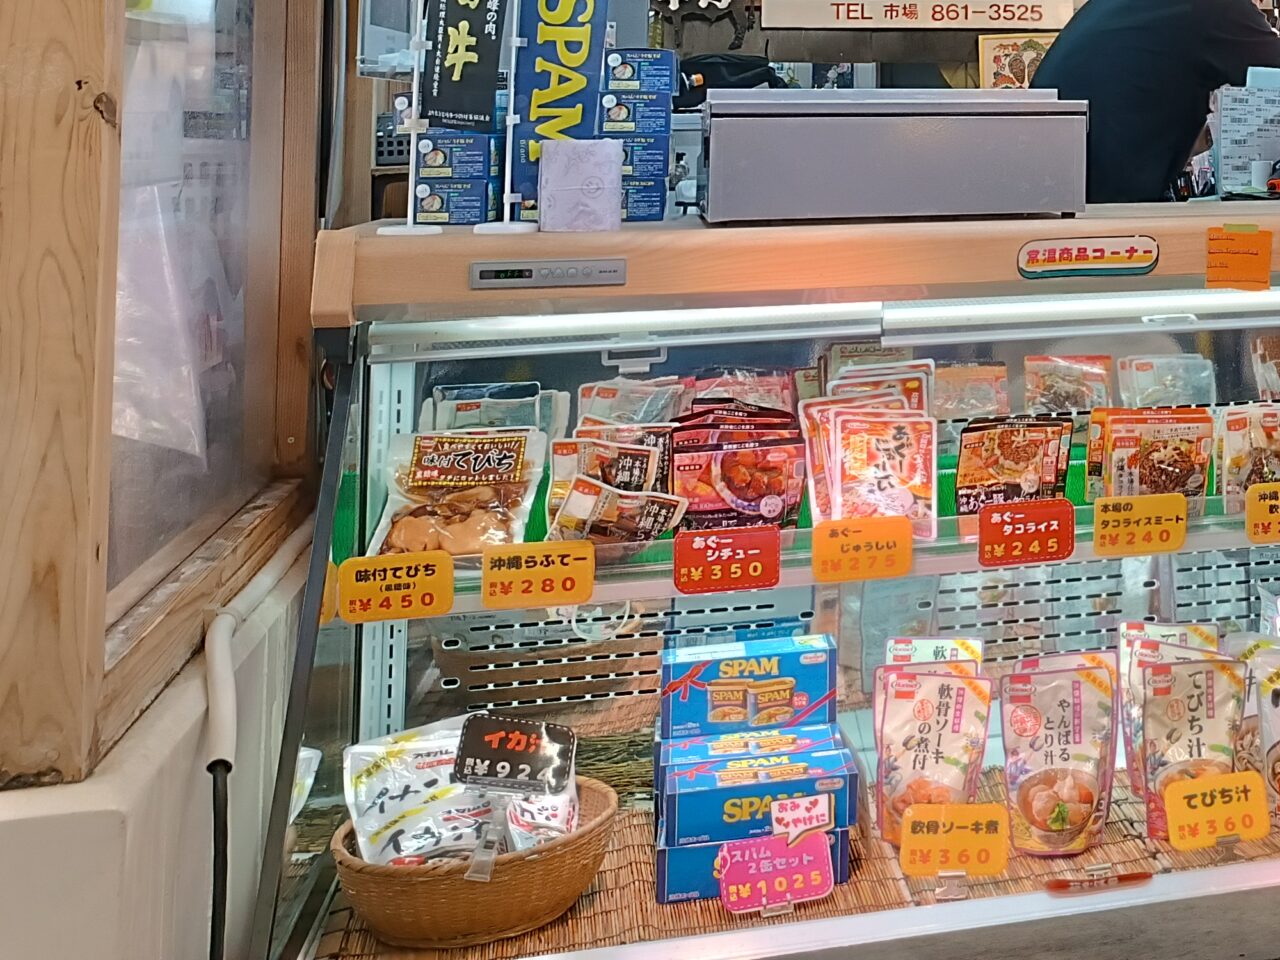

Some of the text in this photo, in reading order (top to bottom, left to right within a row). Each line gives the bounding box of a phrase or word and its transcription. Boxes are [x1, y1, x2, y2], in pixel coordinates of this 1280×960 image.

[830, 2, 1043, 23] TEL 市場 861-3525
[1026, 245, 1154, 265] 常温商品コーナー
[422, 449, 516, 475] 味付てびち
[1258, 491, 1280, 502] 沖縄
[1100, 502, 1134, 514] 本場の
[990, 512, 1025, 524] あぐー
[1100, 514, 1185, 530] タコライスミート
[828, 527, 863, 538] あぐー
[1002, 520, 1060, 536] タコライス
[1107, 528, 1171, 546] ¥240
[691, 535, 734, 550] あぐー
[840, 540, 898, 554] じゅうしい
[993, 538, 1060, 558] ¥245
[489, 553, 588, 572] 沖縄らふてー
[706, 547, 762, 562] シチュー
[829, 553, 898, 573] ¥275
[354, 562, 437, 583] 味付てびち
[690, 561, 764, 580] ¥350
[499, 577, 577, 597] ¥280
[358, 592, 436, 613] ¥450
[719, 656, 780, 678] SPAM
[712, 690, 744, 702] SPAM
[757, 689, 791, 704] SPAM
[931, 683, 954, 764] 軟骨ソーキ
[1186, 670, 1207, 759] てびち汁
[1057, 698, 1071, 762] やんばる
[912, 722, 932, 771] の煮付
[1043, 716, 1057, 766] とり汁
[727, 755, 791, 769] SPAM
[1182, 784, 1252, 810] てびち汁
[910, 819, 1000, 836] 軟骨ソーキ煮
[1186, 813, 1255, 839] ¥360
[731, 847, 771, 862] スパム
[748, 854, 815, 874] 2缶セット
[918, 847, 990, 865] ¥360
[738, 870, 823, 898] ¥1025
